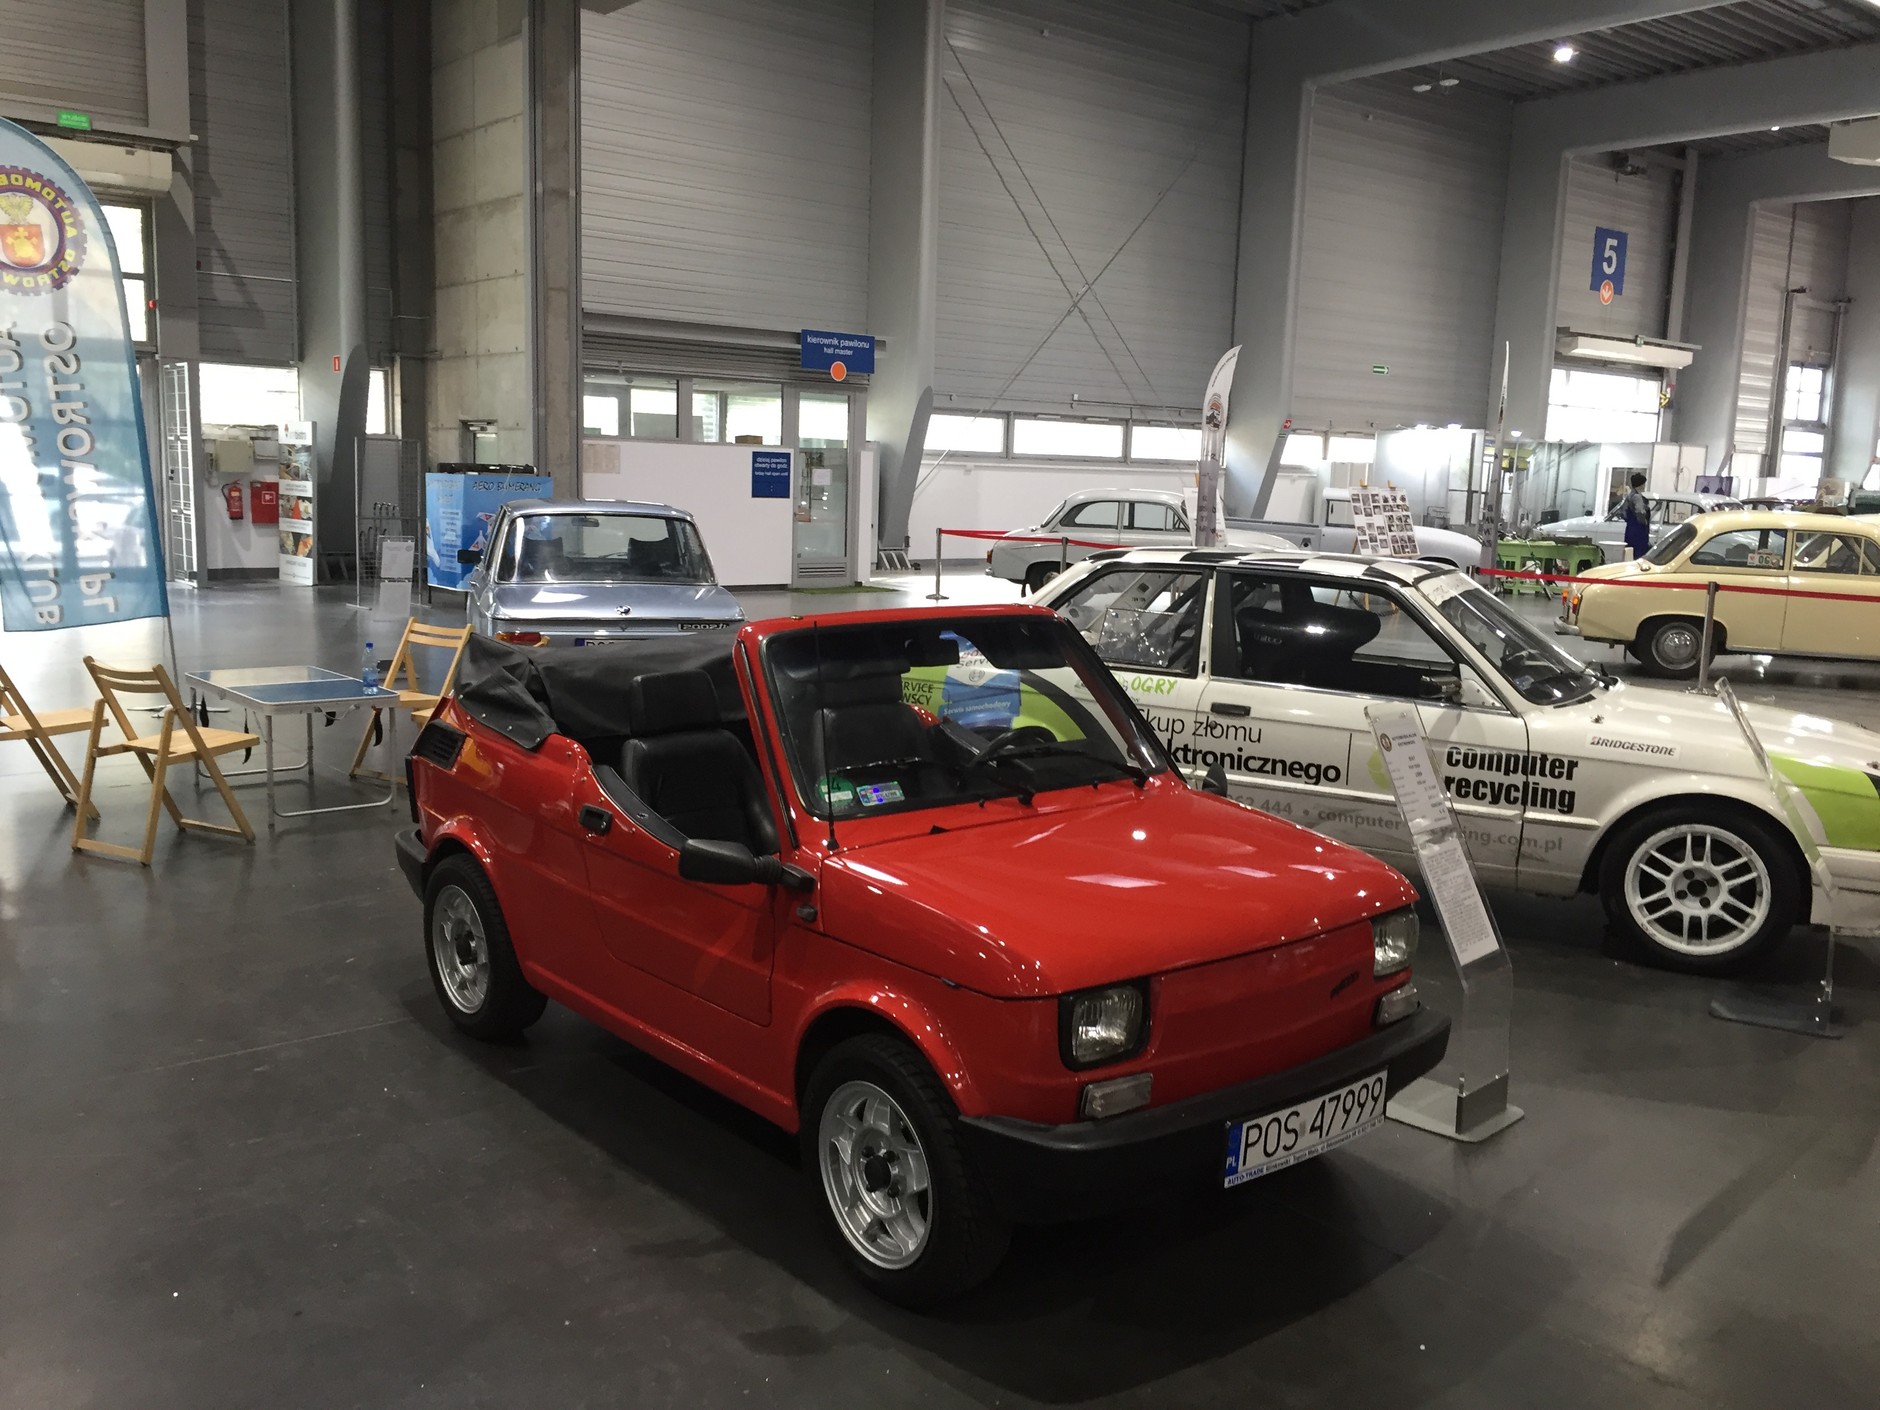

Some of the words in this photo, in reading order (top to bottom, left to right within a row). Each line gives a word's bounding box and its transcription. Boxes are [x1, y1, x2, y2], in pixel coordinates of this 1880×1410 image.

[1602, 237, 1618, 275] 5
[806, 334, 839, 346] kierownik
[840, 339, 870, 349] pawilonu
[834, 348, 853, 356] master
[472, 481, 495, 492] AERO
[902, 680, 935, 694] RVICE
[1131, 676, 1177, 695] OGRY
[1191, 714, 1262, 744] złomu
[1590, 736, 1677, 757] BRIDGESTONE
[1446, 747, 1579, 781] computer
[1444, 774, 1576, 815] recycling
[1260, 799, 1293, 815] 444
[1242, 1110, 1300, 1167] POS
[1309, 1076, 1384, 1140] 47999
[1225, 1154, 1237, 1170] PL
